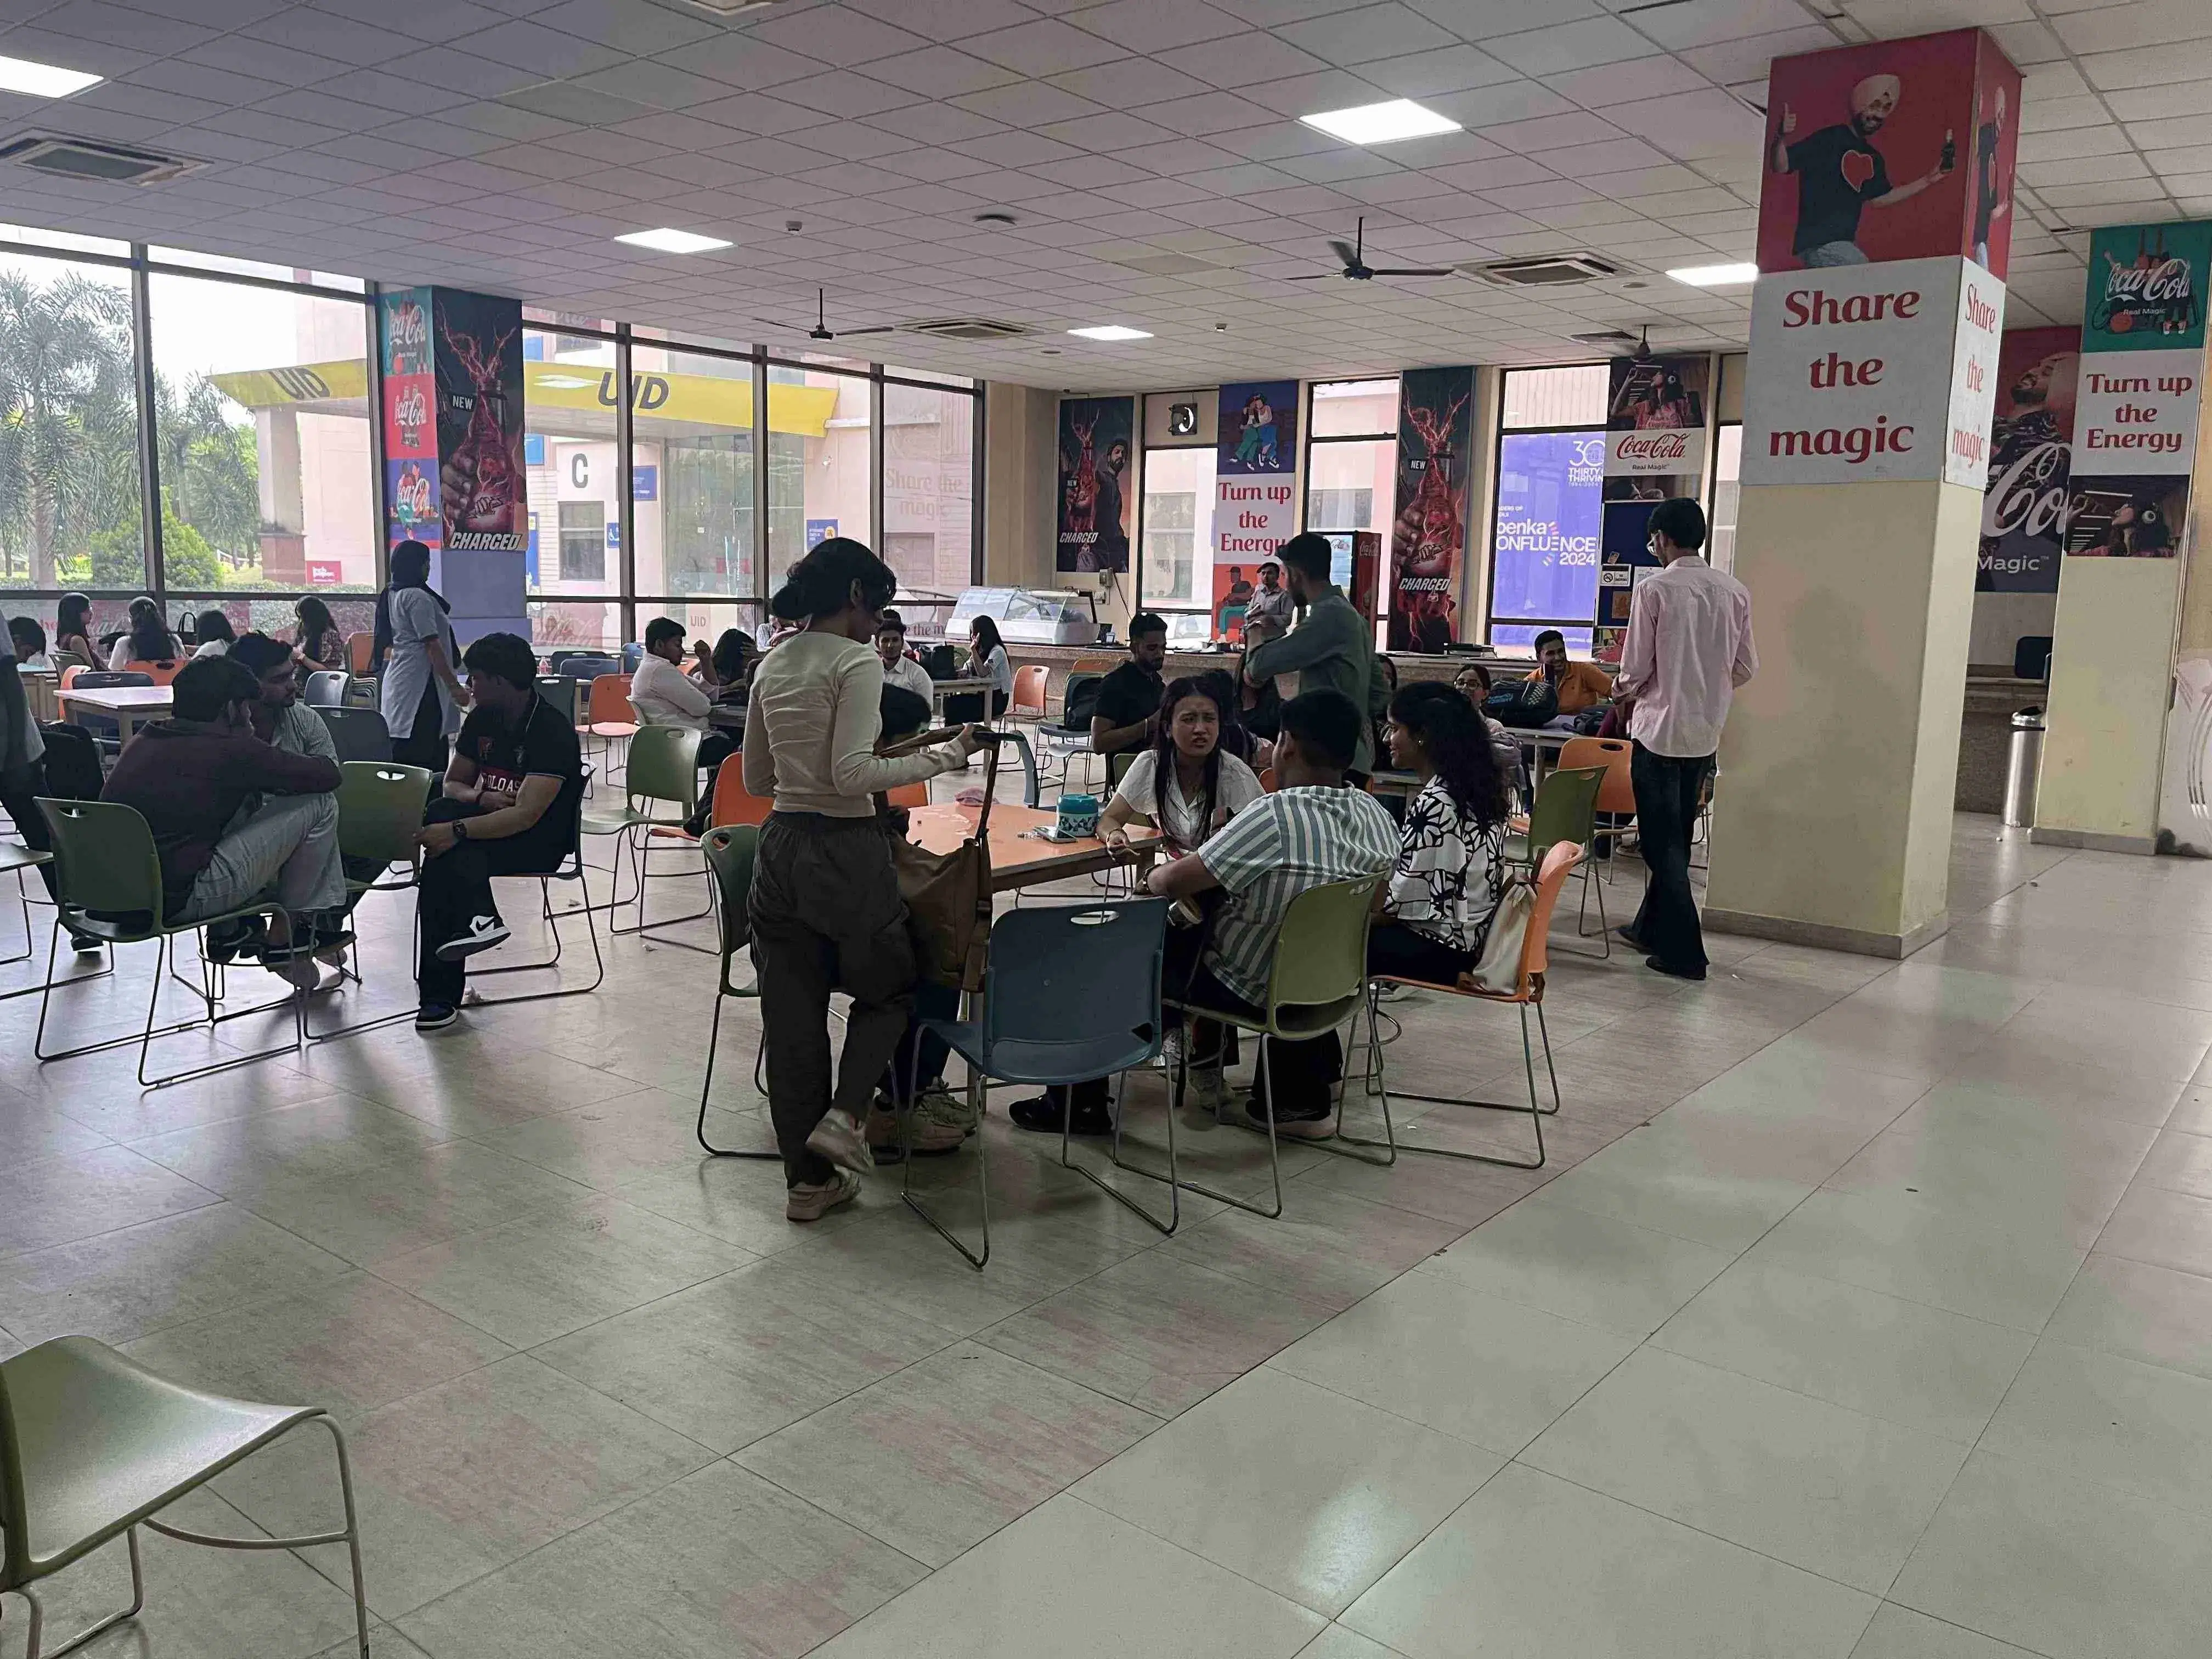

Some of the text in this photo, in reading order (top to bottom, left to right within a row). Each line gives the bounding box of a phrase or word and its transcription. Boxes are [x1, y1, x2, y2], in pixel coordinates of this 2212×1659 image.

[1783, 290, 1920, 328] Share
[1966, 283, 1996, 334] Share
[1809, 352, 1883, 388] the
[1967, 353, 1984, 393] the
[2086, 374, 2192, 397] Turn up
[452, 394, 473, 410] NEW
[2115, 403, 2158, 423] the
[1616, 433, 1691, 459] Coca-Cola
[1769, 415, 1914, 463] magic
[1952, 424, 1984, 469] magic
[2087, 428, 2182, 453] Energy
[572, 453, 588, 488] C
[1410, 460, 1426, 470] NEW
[1568, 467, 1601, 475] THIRTY
[1219, 482, 1291, 504] Turn up
[1239, 510, 1268, 529] the
[449, 532, 522, 550] CHARGED
[1059, 532, 1099, 543] CHARGED
[1559, 551, 1596, 566] 2024
[1398, 578, 1451, 591] CHARGED
